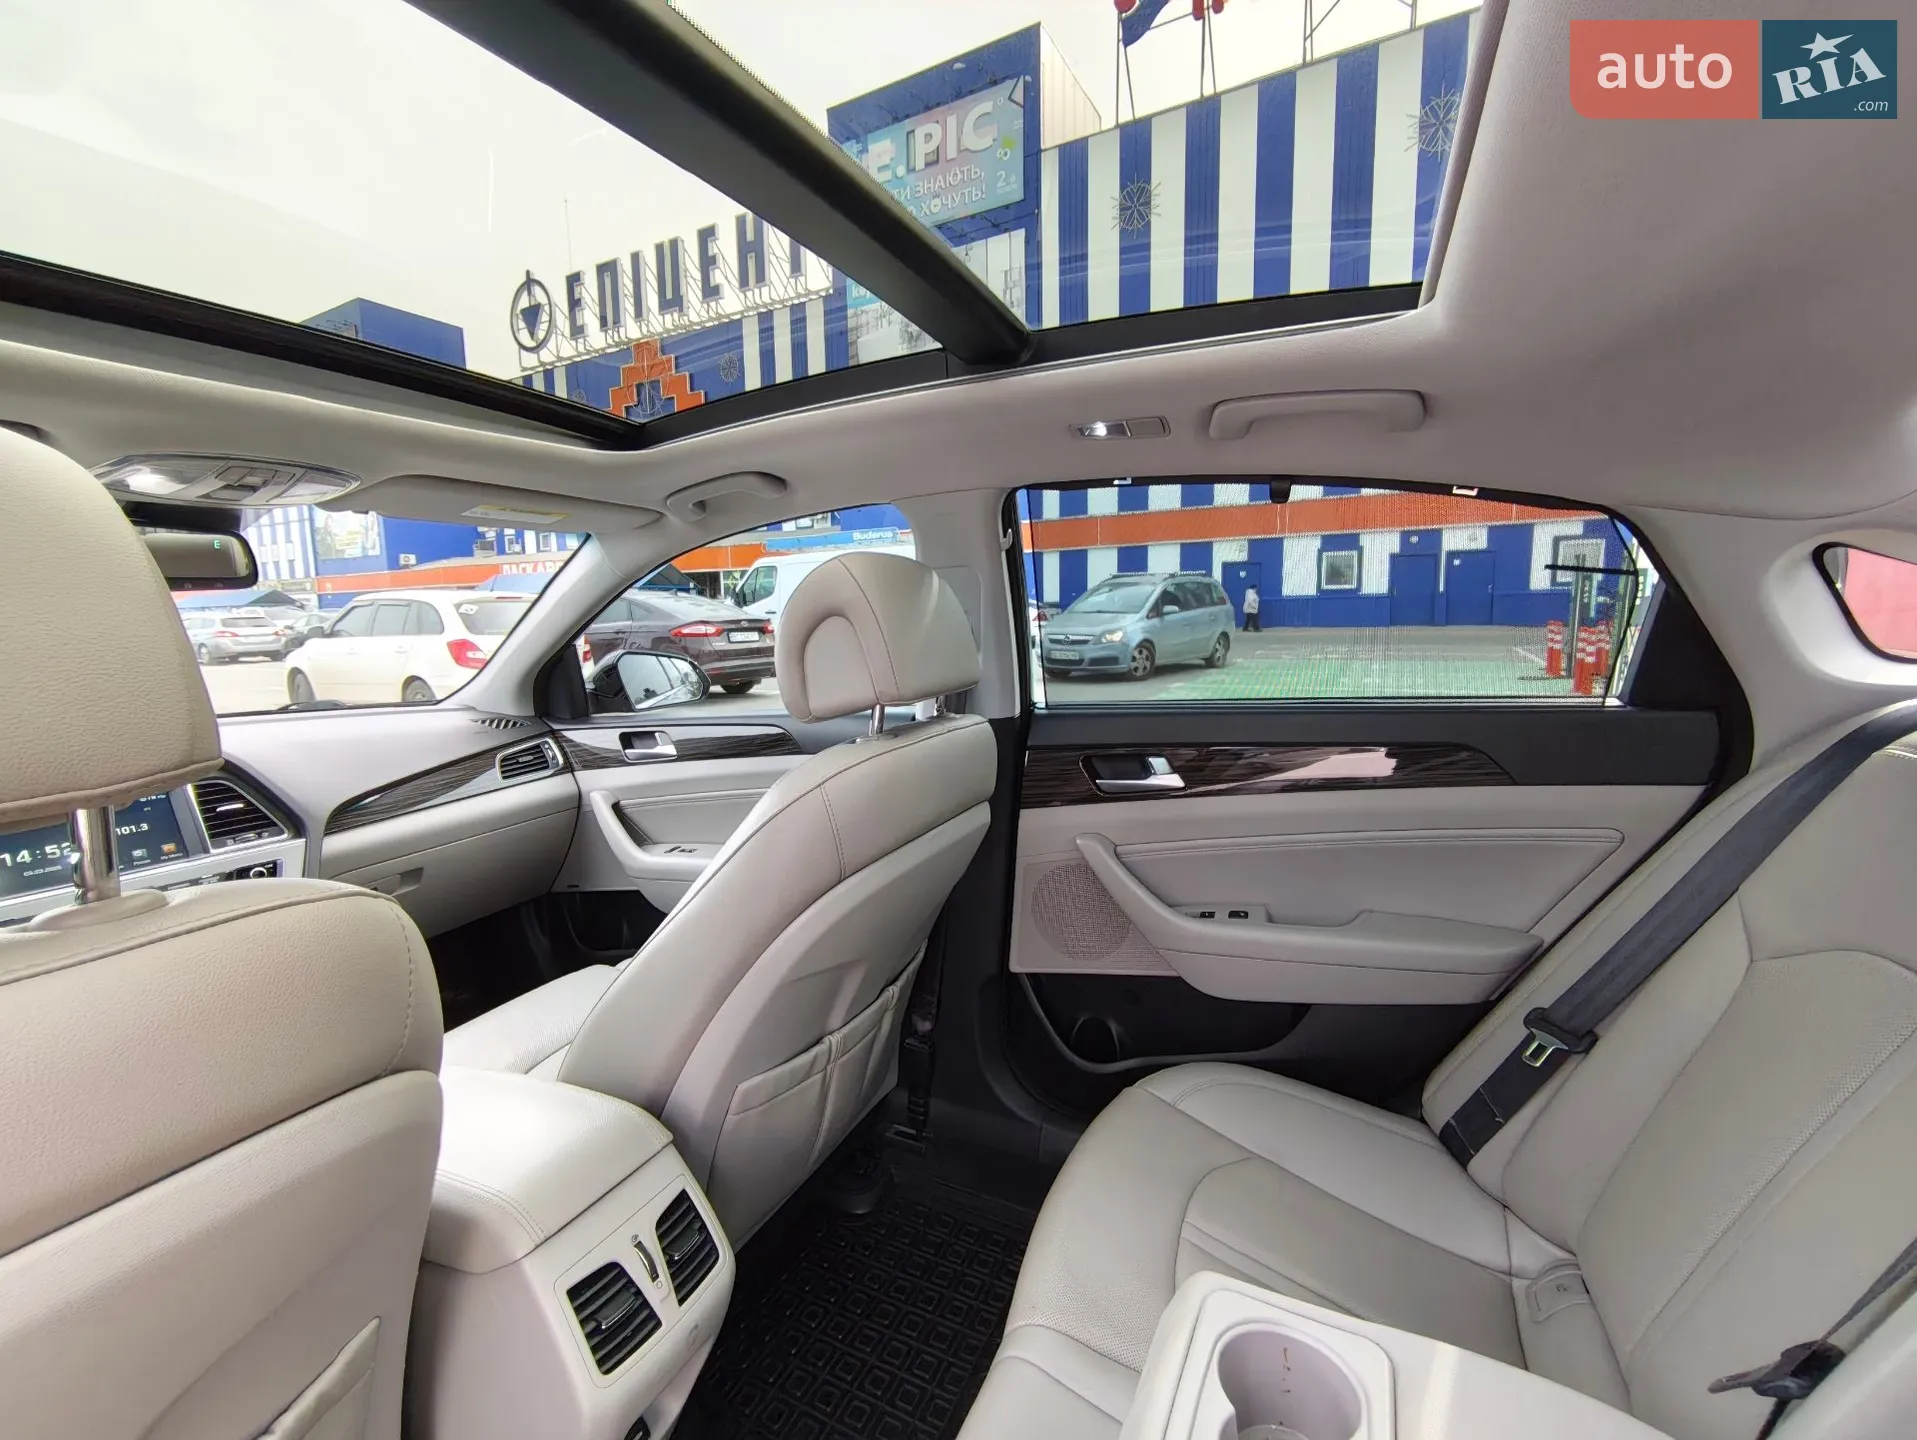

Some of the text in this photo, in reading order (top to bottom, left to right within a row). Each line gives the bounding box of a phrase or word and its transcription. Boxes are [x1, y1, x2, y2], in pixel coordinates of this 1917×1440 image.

[853, 530, 893, 540] Buderus
[115, 823, 149, 836] 101.3
[0, 842, 73, 867] 14:52
